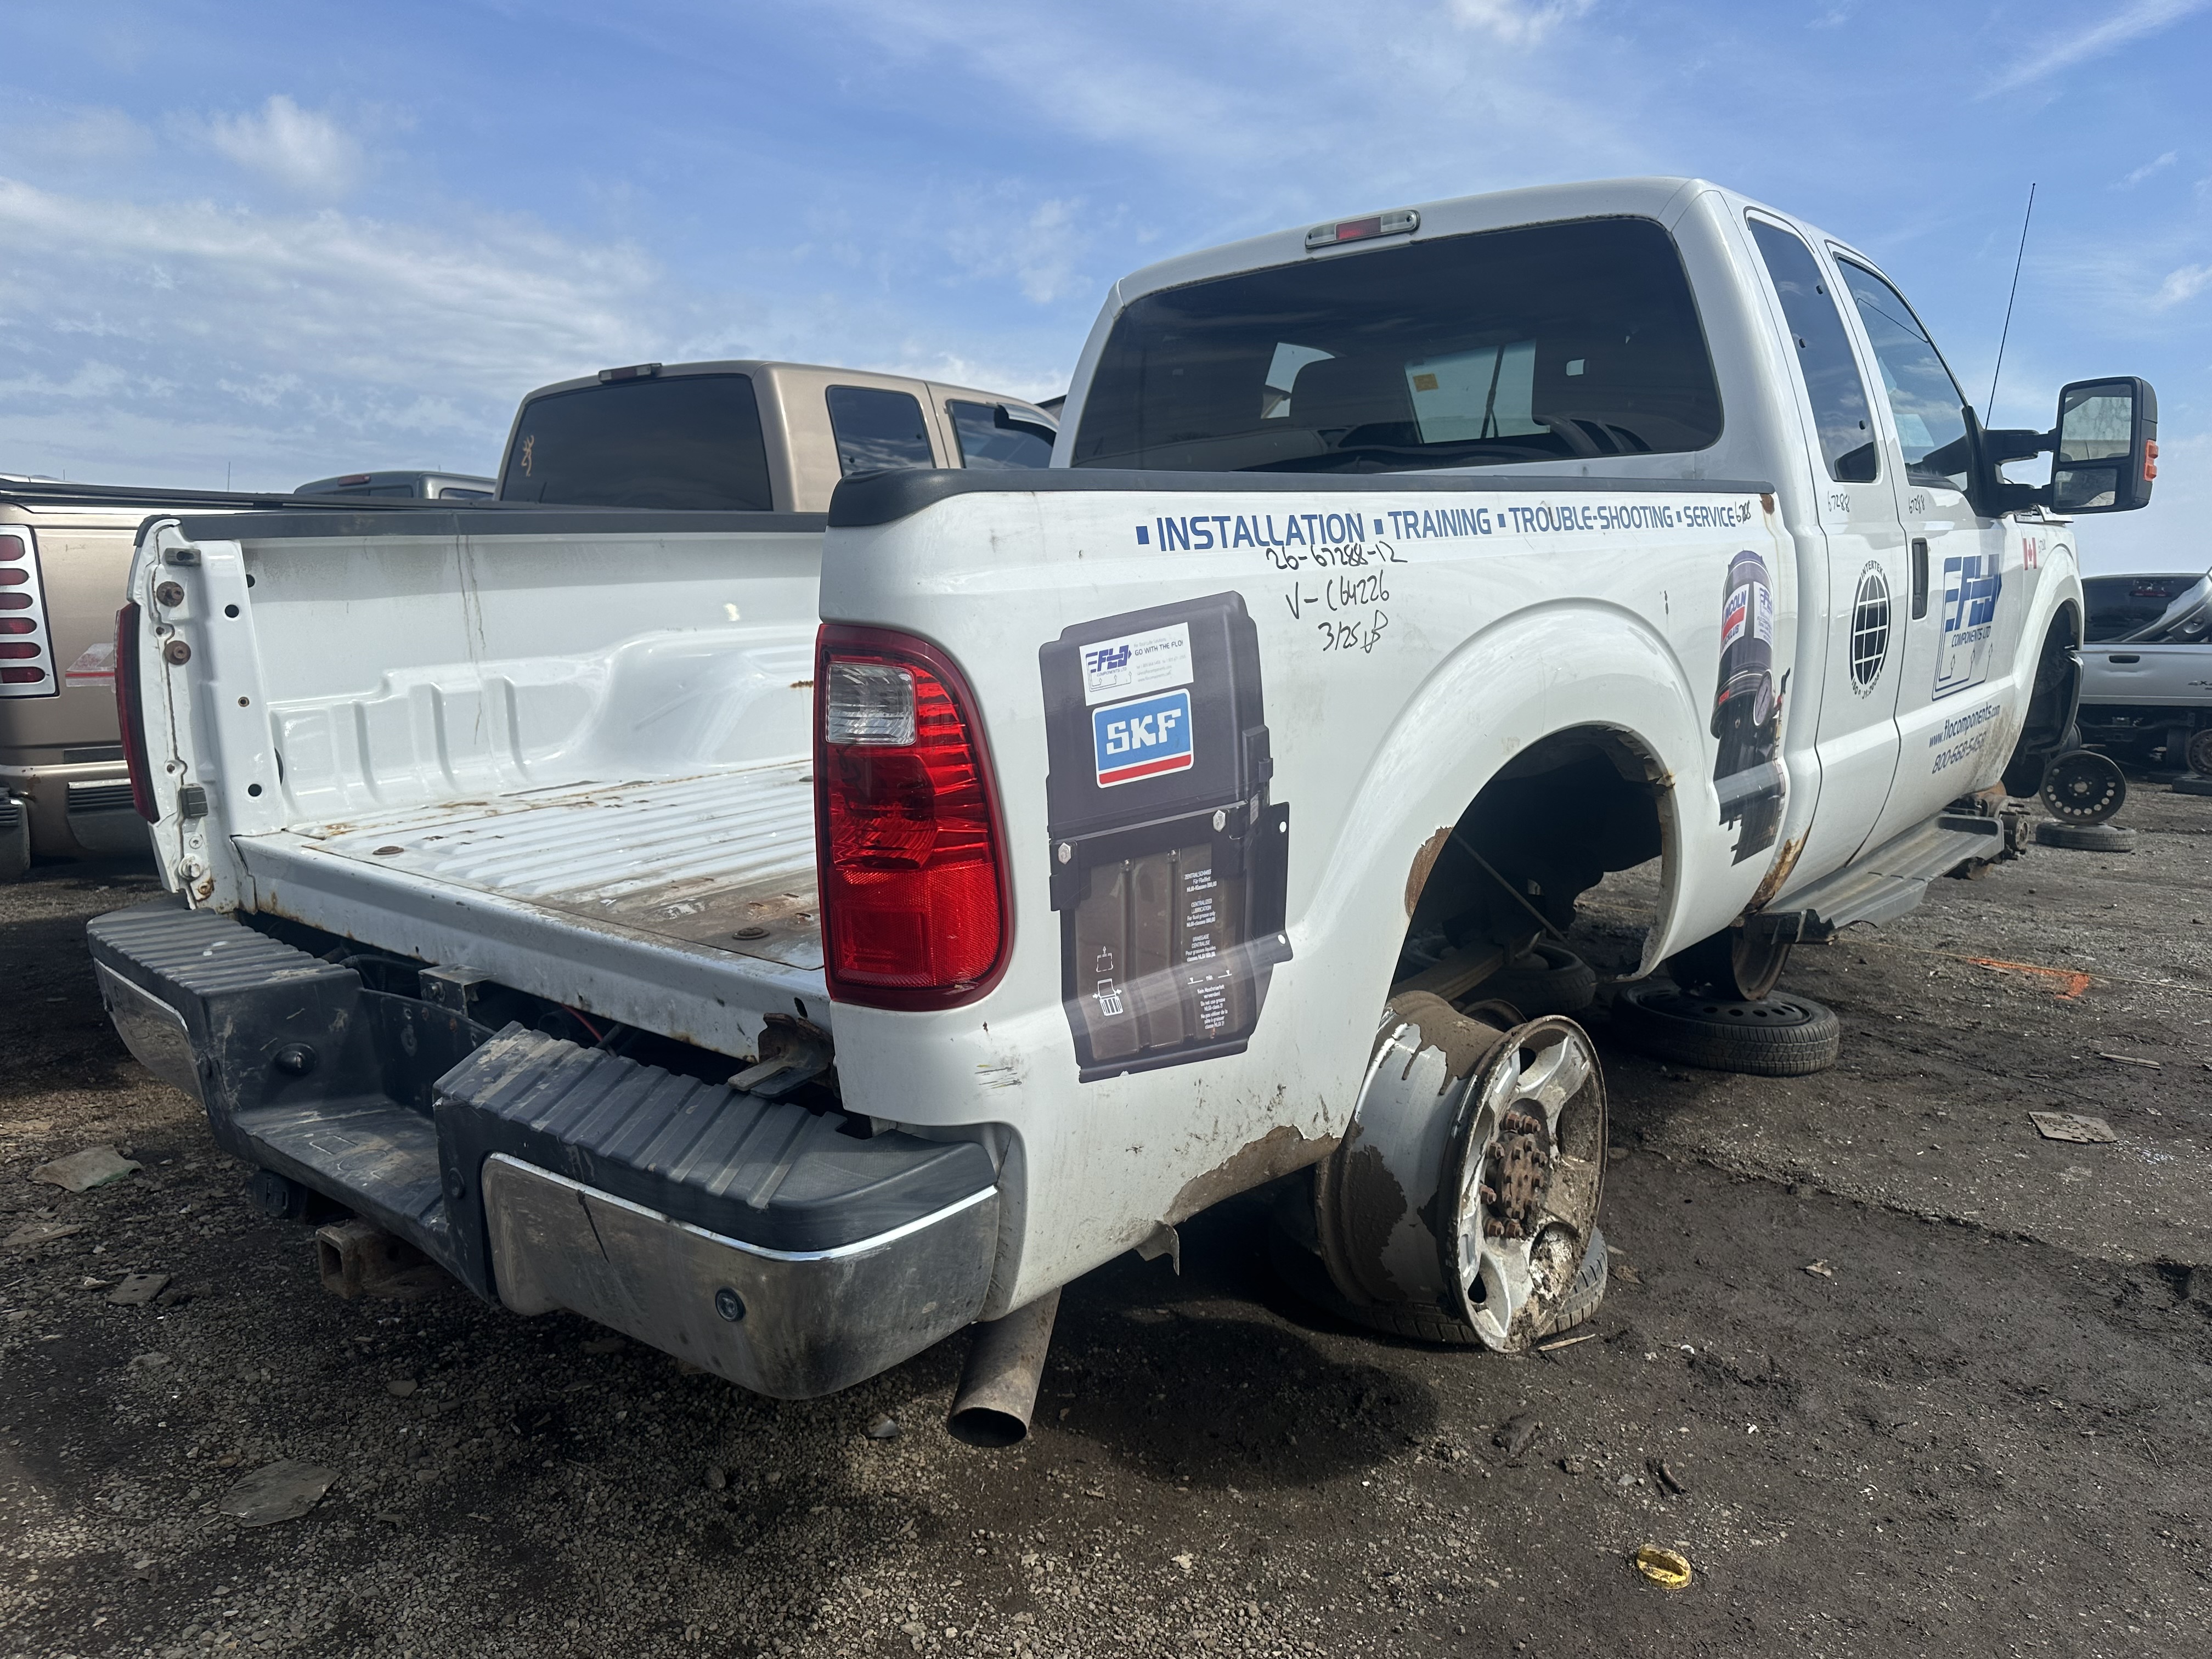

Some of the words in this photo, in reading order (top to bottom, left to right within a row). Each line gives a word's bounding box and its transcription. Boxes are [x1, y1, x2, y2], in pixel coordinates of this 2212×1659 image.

[1827, 490, 1850, 512] 67288
[1909, 494, 1925, 514] 67288
[1156, 513, 1365, 552] INSTALLATION
[1387, 508, 1492, 540] TRAINING
[1509, 506, 1673, 533] TROUBLE-SHOOTING
[1684, 507, 1736, 527] SERVICE
[1266, 540, 1408, 570] 26-67288-12
[1951, 628, 1983, 648] COMPONENTS
[1983, 625, 1991, 639] LTD
[1144, 646, 1158, 654] WITH
[1106, 708, 1181, 755] SKF
[1929, 702, 2000, 748] www.flocomponents.com
